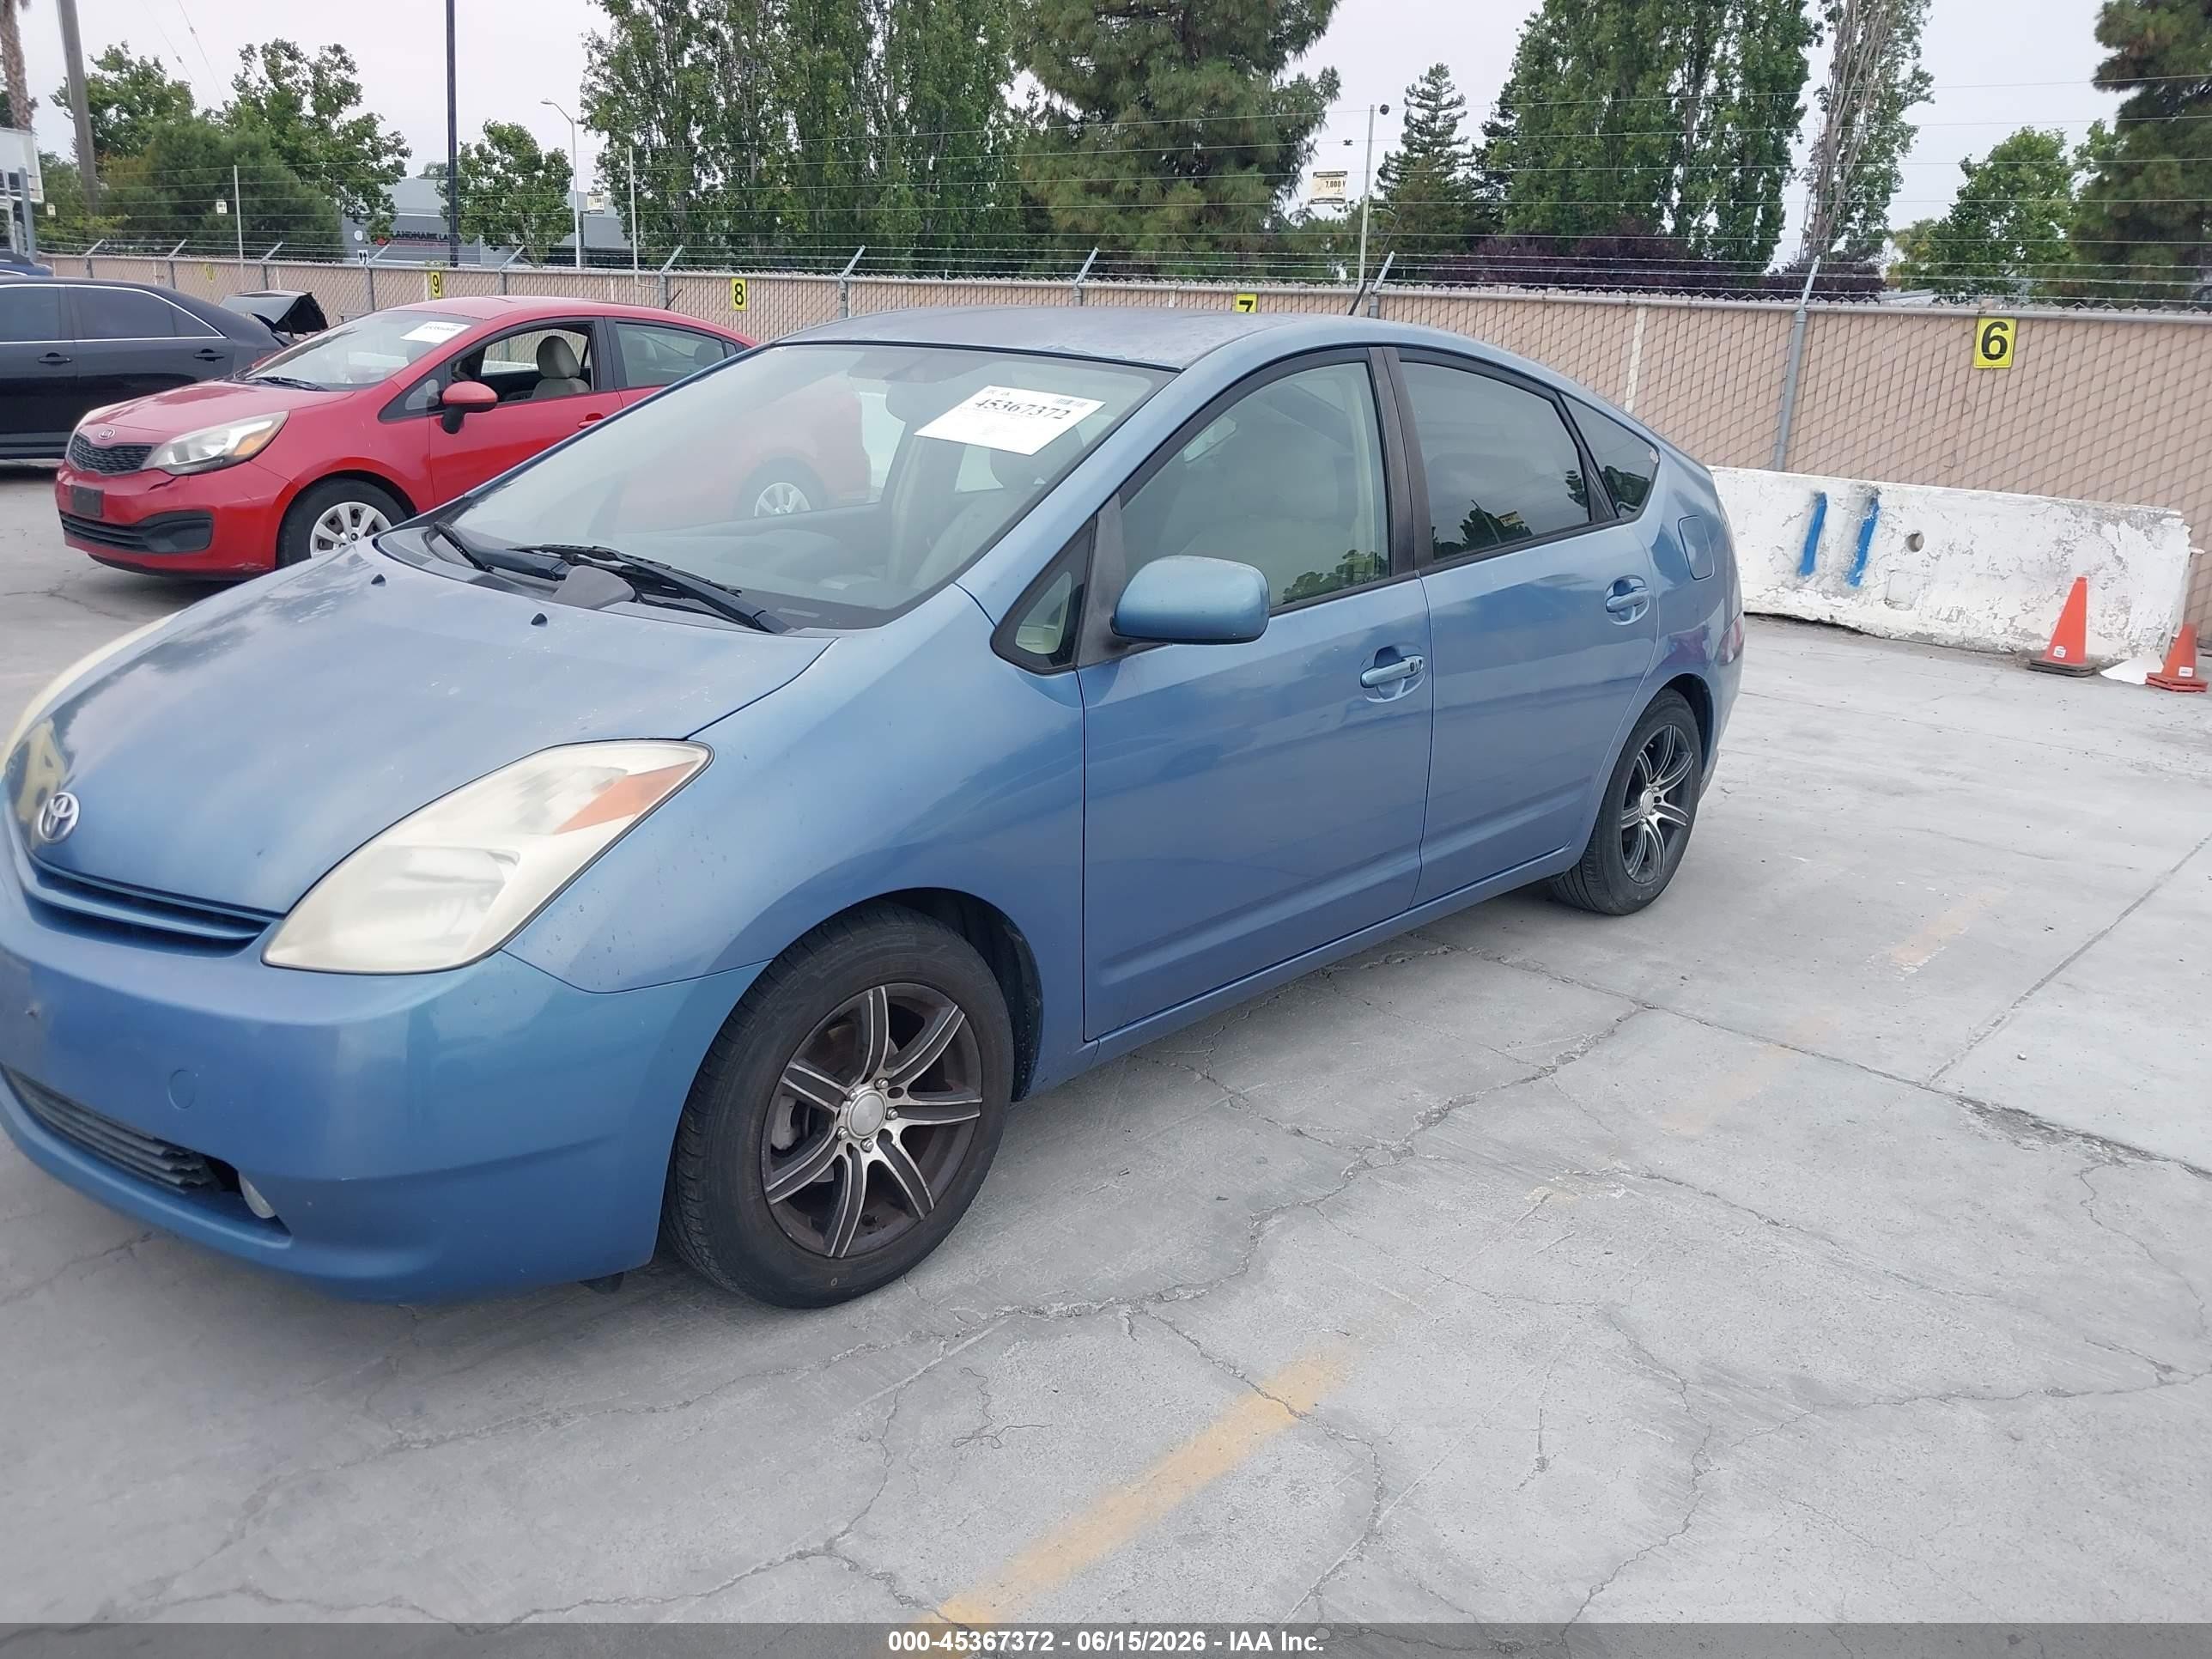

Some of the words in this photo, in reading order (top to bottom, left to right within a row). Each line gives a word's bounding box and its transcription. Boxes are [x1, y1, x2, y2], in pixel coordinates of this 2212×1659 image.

[1325, 180, 1341, 189] 7,000
[391, 230, 438, 240] LANDMARK
[432, 274, 440, 294] 9
[734, 283, 744, 306] 8
[1238, 300, 1254, 313] 7
[1982, 321, 2008, 361] 6
[975, 398, 1072, 419] 45367372
